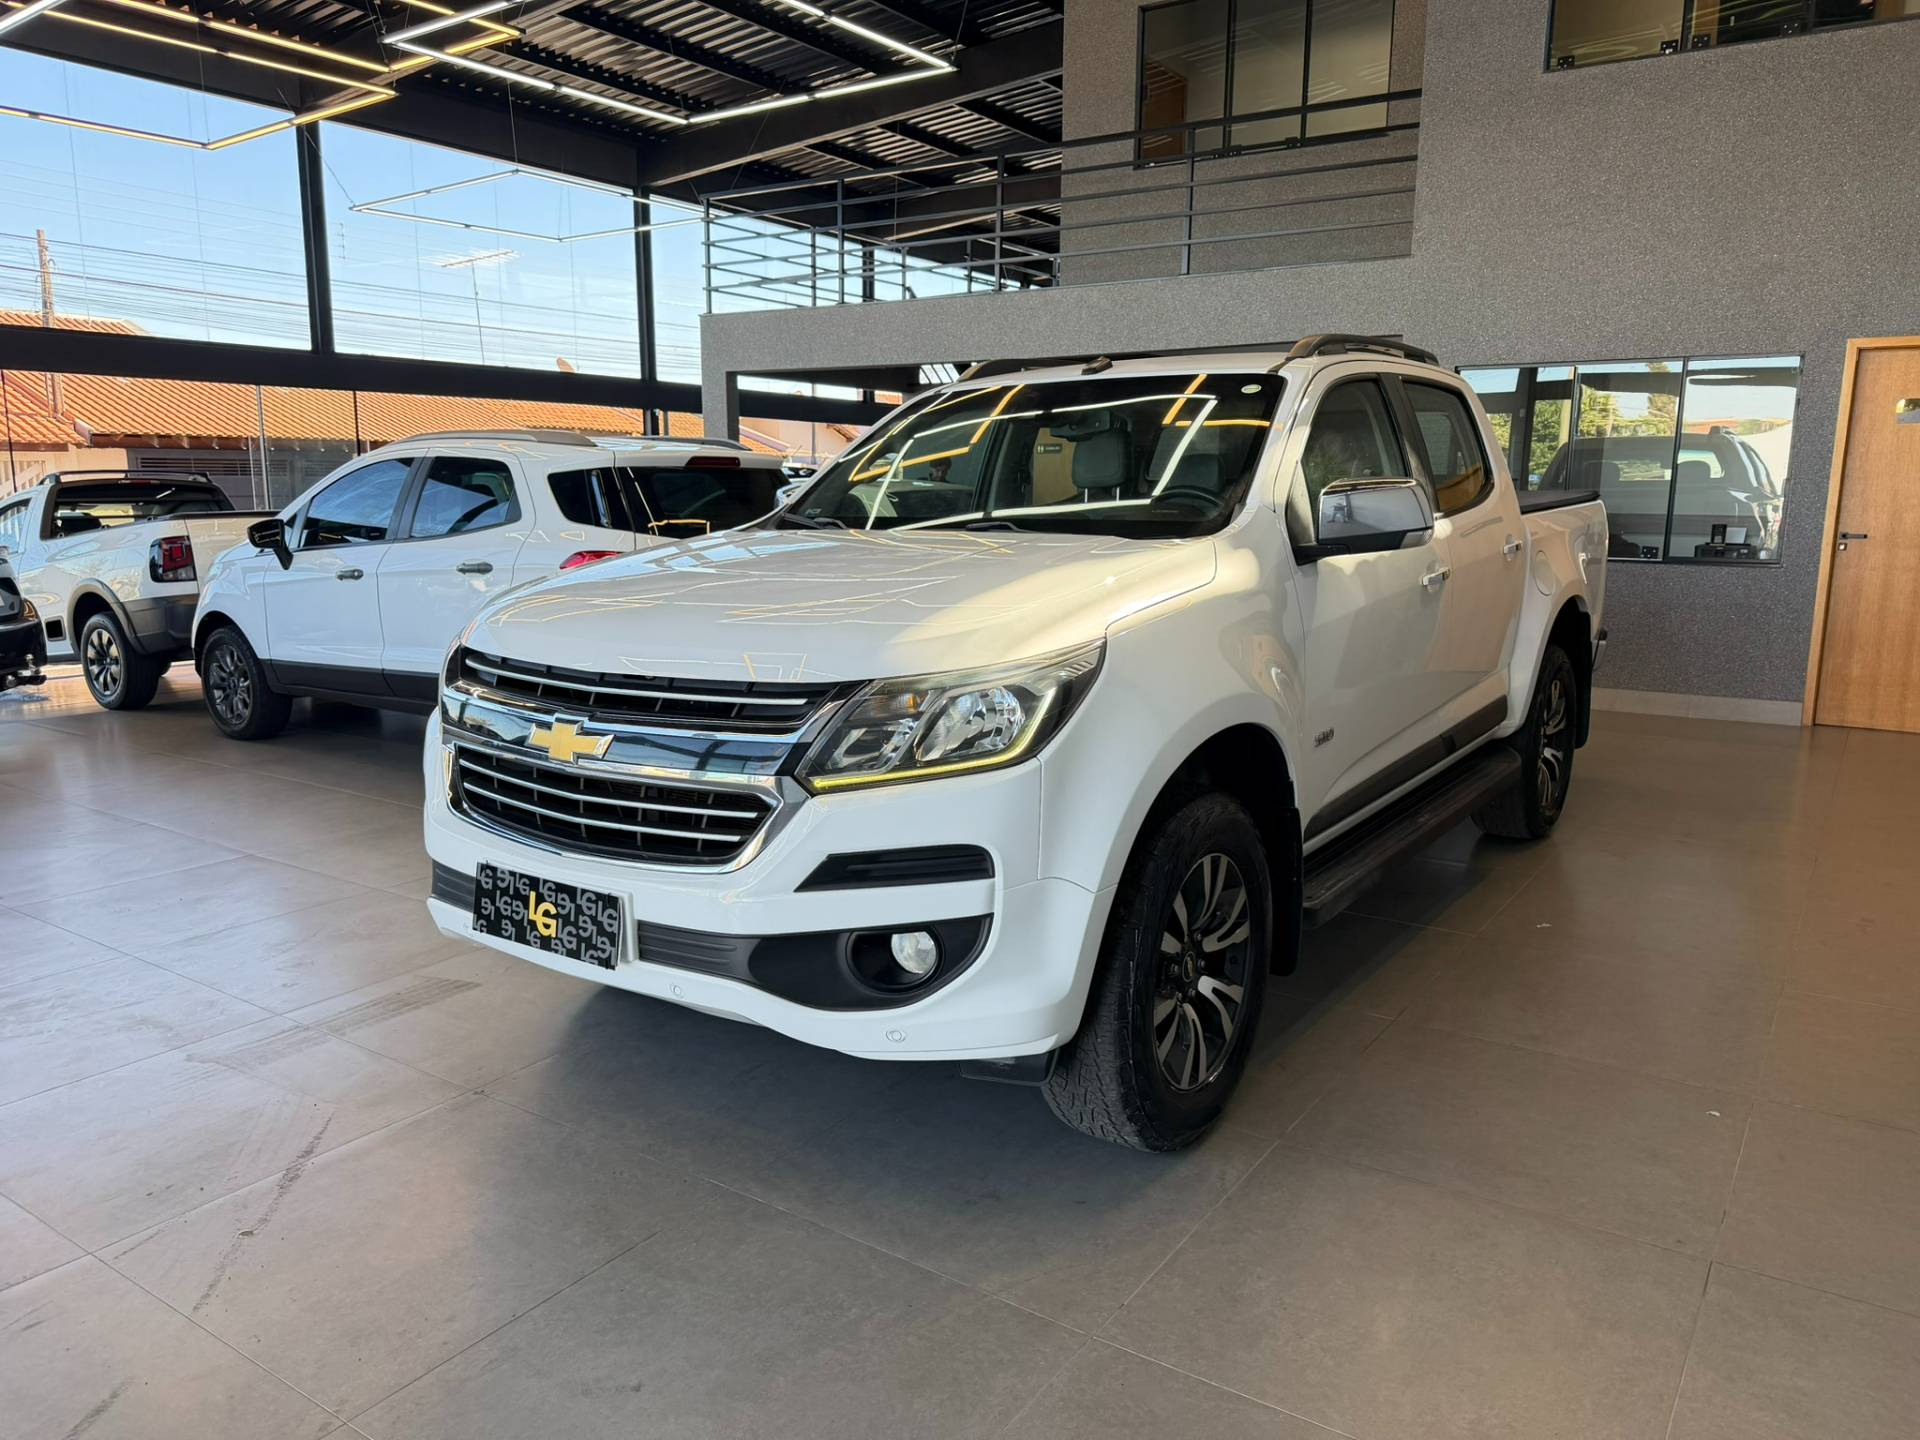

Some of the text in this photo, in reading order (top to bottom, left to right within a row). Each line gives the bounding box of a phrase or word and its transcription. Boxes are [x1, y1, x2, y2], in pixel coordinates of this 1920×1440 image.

[478, 863, 492, 890] LG
[516, 873, 530, 895] LG
[496, 891, 512, 916] LG
[539, 879, 555, 902] LG
[577, 887, 596, 915] LG
[529, 891, 558, 938] LG
[598, 901, 618, 933] LG
[527, 926, 540, 949] LG
[557, 919, 577, 950] LG
